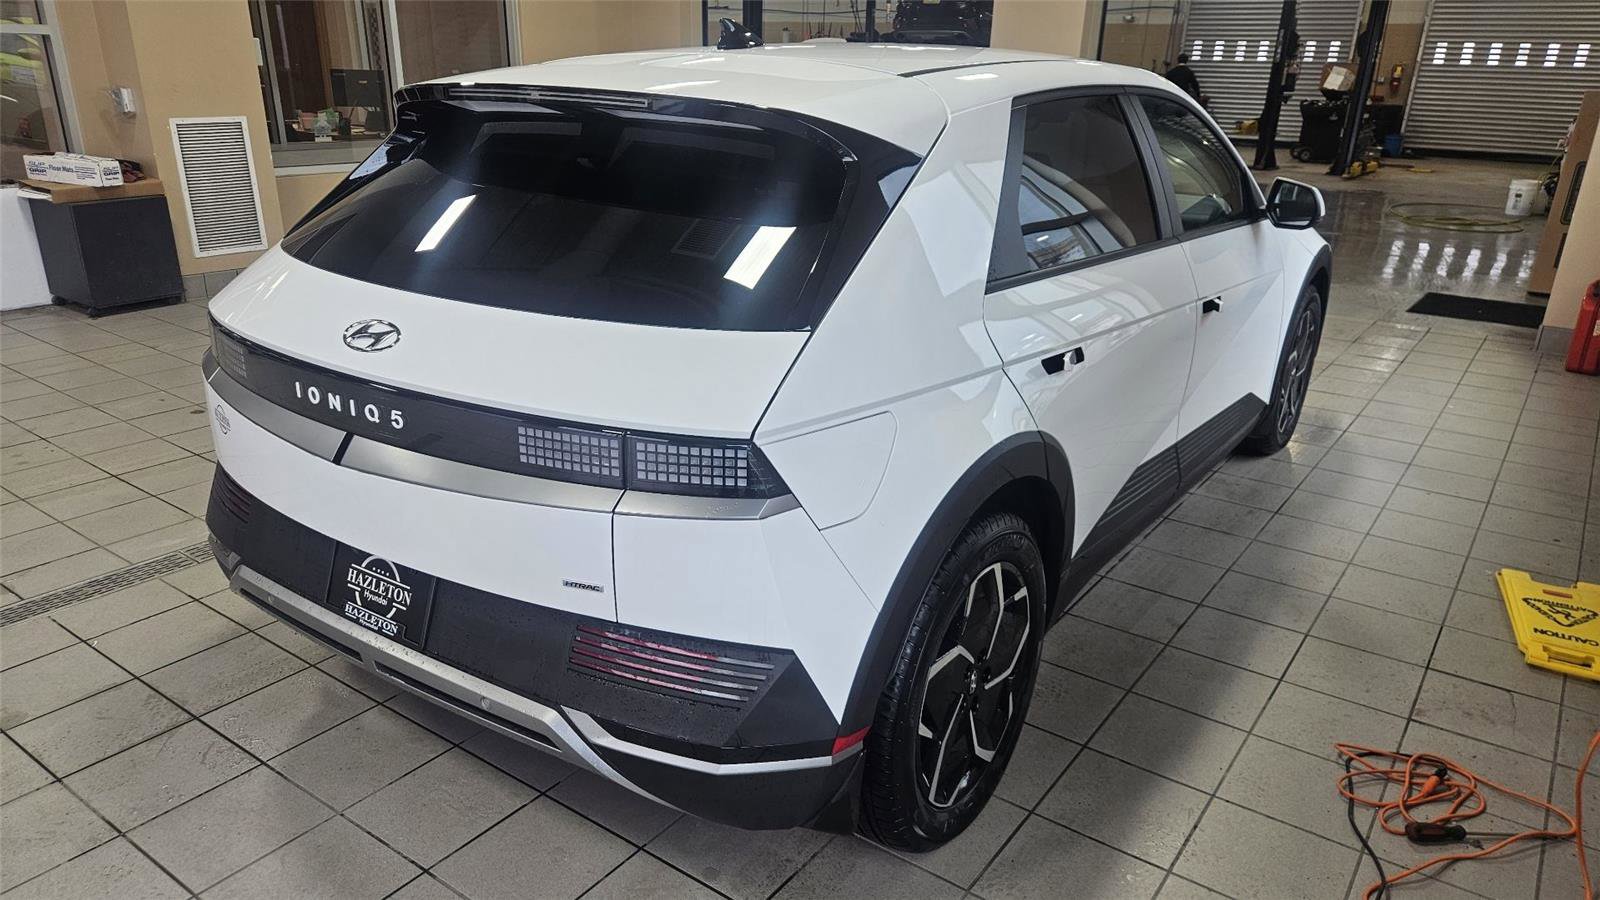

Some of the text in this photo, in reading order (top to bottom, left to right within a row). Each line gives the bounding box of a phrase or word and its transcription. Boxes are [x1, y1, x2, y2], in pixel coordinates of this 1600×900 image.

[294, 380, 405, 430] IONIQ 5
[347, 568, 412, 606] HAZLETON
[363, 589, 389, 606] Hyundai
[564, 580, 602, 592] HTRAC
[344, 603, 399, 634] HAZLETON
[1533, 627, 1599, 647] CAUTION
